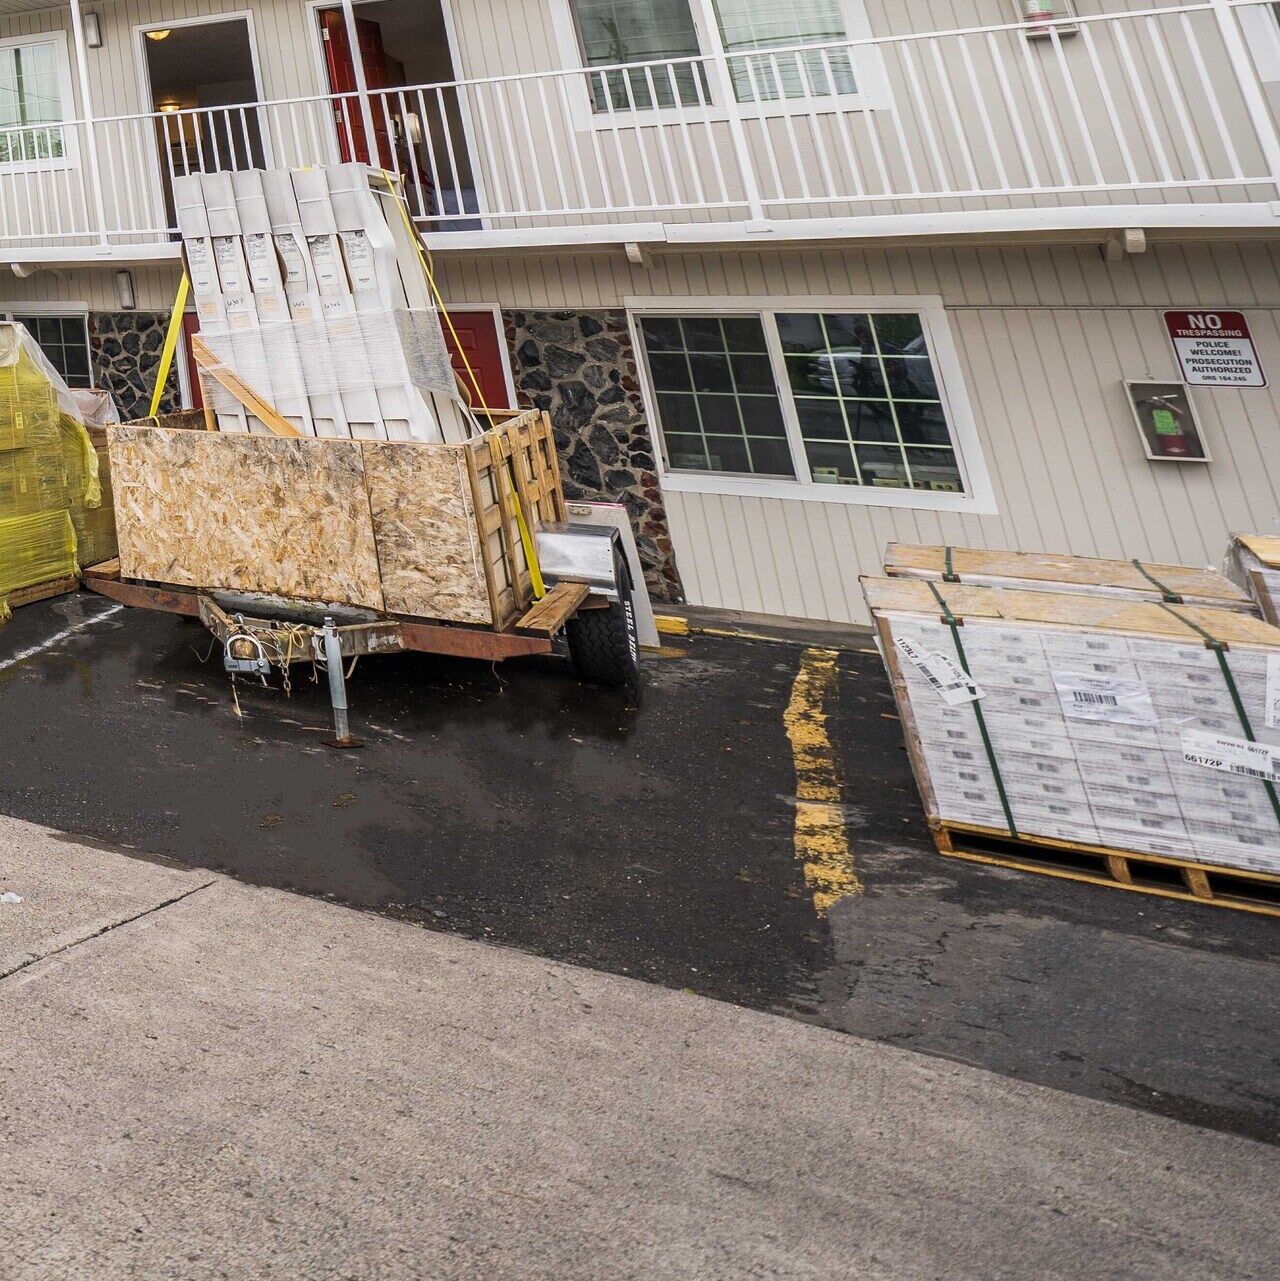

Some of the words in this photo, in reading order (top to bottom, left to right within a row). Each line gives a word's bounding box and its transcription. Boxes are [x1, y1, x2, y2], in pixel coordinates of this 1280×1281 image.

[1187, 314, 1222, 329] NO
[1176, 329, 1243, 337] TRESPASSING
[1185, 357, 1253, 366] PROSECUTION
[1192, 366, 1252, 374] AUTHORIZED
[623, 600, 634, 631] STEEL
[1184, 753, 1223, 767] 66172P
